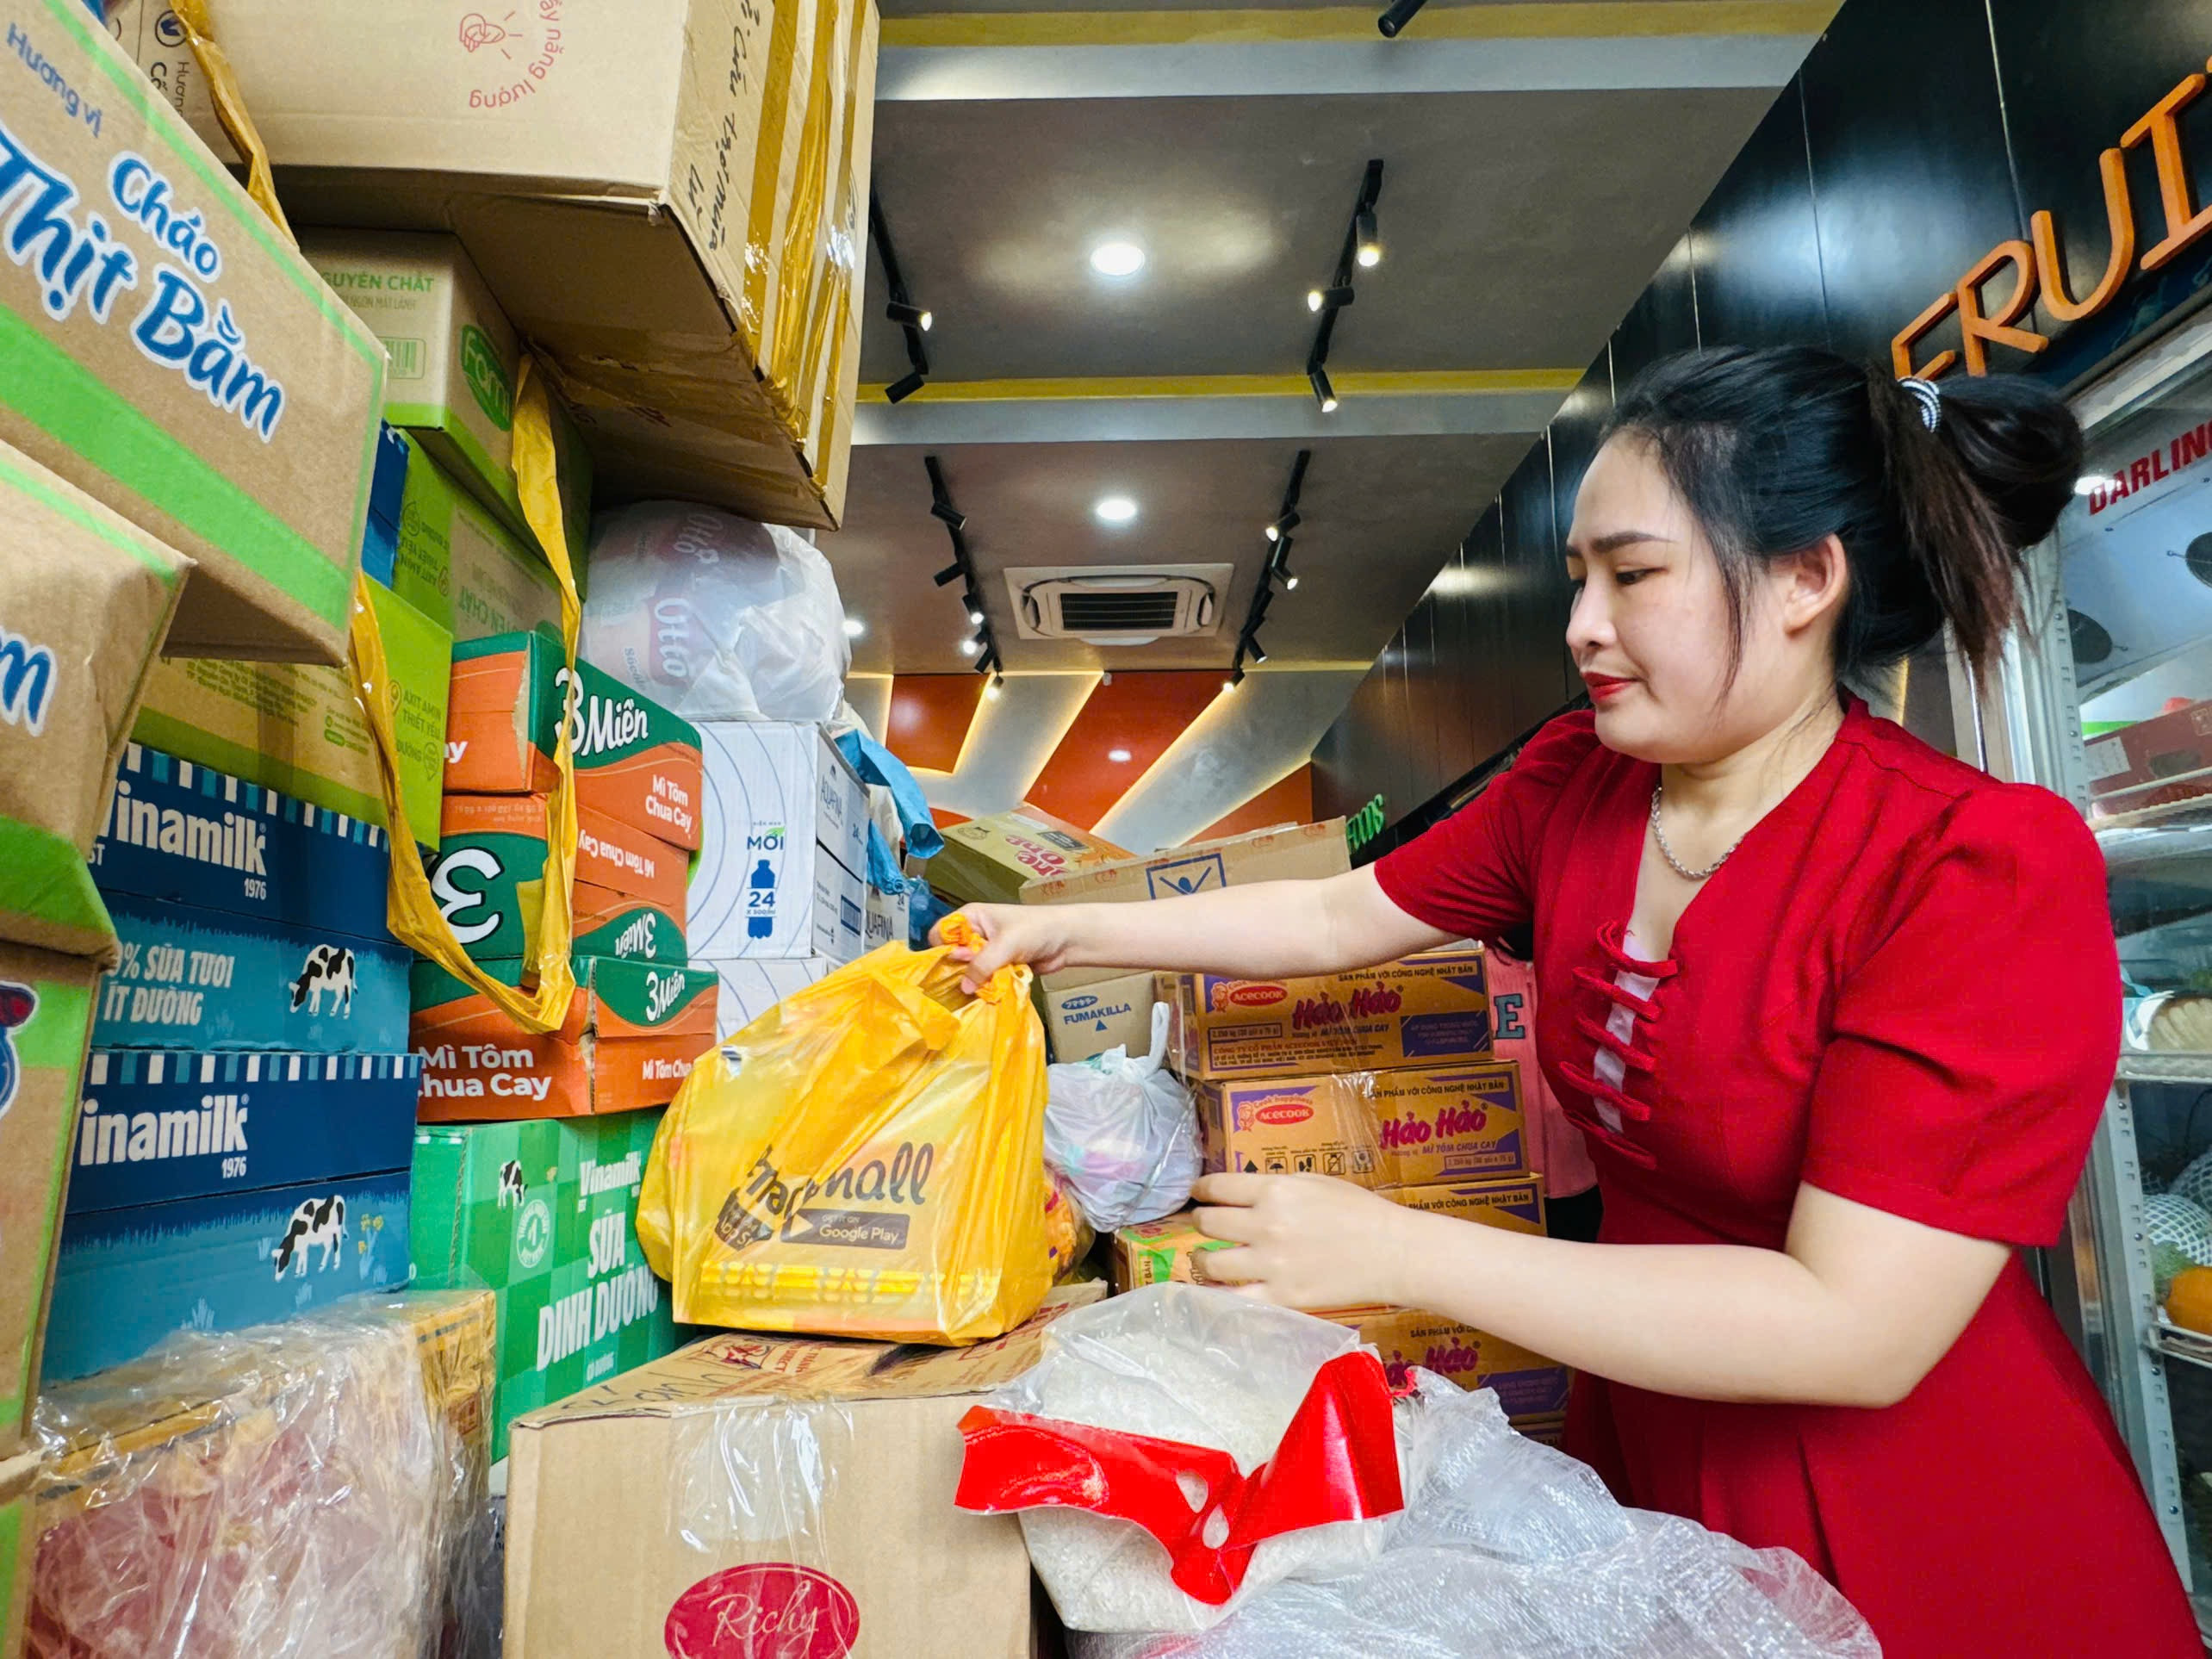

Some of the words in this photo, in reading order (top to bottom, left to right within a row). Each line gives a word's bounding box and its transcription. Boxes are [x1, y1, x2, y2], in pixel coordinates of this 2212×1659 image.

[528, 28, 564, 80] năng
[7, 22, 78, 117] Hương
[84, 107, 103, 139] vị
[469, 79, 536, 109] lượng
[111, 156, 220, 276] Cháo
[1892, 60, 2212, 377] FRUI
[323, 271, 382, 290] GUYÊN
[387, 271, 434, 293] CHẤT
[134, 270, 283, 439] Bằm
[2090, 419, 2212, 516] DARLIN
[554, 668, 587, 756] 3
[581, 694, 649, 757] Miền
[653, 774, 667, 793] Mì
[666, 779, 688, 807] Tôm
[100, 780, 267, 876] inamilk
[645, 797, 672, 820] Chua
[671, 807, 693, 836] Cay
[578, 830, 600, 859] Cay
[600, 842, 624, 868] Chua
[244, 878, 267, 900] 1976
[748, 891, 775, 908] 24
[615, 916, 645, 959] Miền
[865, 910, 894, 939] QUAFINA
[144, 943, 185, 985] SỮA
[1392, 968, 1414, 979] CÔNG
[103, 980, 130, 1022] ÍT
[130, 984, 203, 1026] ĐƯỜNG
[646, 971, 661, 1022] 3
[658, 970, 687, 1020] Miền
[1063, 1003, 1132, 1025] FUMAKILLA
[1293, 991, 1345, 1030] Hảo
[1348, 981, 1402, 1020] Hảo
[1493, 993, 1525, 1041] E
[419, 1045, 457, 1069] Mì
[462, 1043, 534, 1069] Tôm
[643, 1059, 655, 1080] Mì
[655, 1058, 673, 1080] Tôm
[419, 1074, 484, 1097] hua
[490, 1073, 552, 1102] Cay
[1407, 1084, 1420, 1096] VỚI
[1420, 1084, 1443, 1095] CÔNG
[1444, 1083, 1464, 1093] NGHỆ
[79, 1094, 249, 1165] inamilk
[1380, 1111, 1432, 1150] Hảo
[1435, 1099, 1488, 1139] Hảo
[1480, 1140, 1497, 1150] CAY
[221, 1157, 247, 1178] 1976
[579, 1151, 642, 1196] Vinamilk
[1446, 1197, 1468, 1208] CÔNG
[1469, 1196, 1490, 1206] NGHỆ
[587, 1208, 626, 1279] SỮA
[819, 1224, 868, 1240] Google
[871, 1227, 899, 1245] Play
[537, 1286, 593, 1371] DINH
[593, 1263, 659, 1342] DƯỠNG
[1426, 1337, 1478, 1375] Hảo
[708, 1579, 820, 1659] Richy
